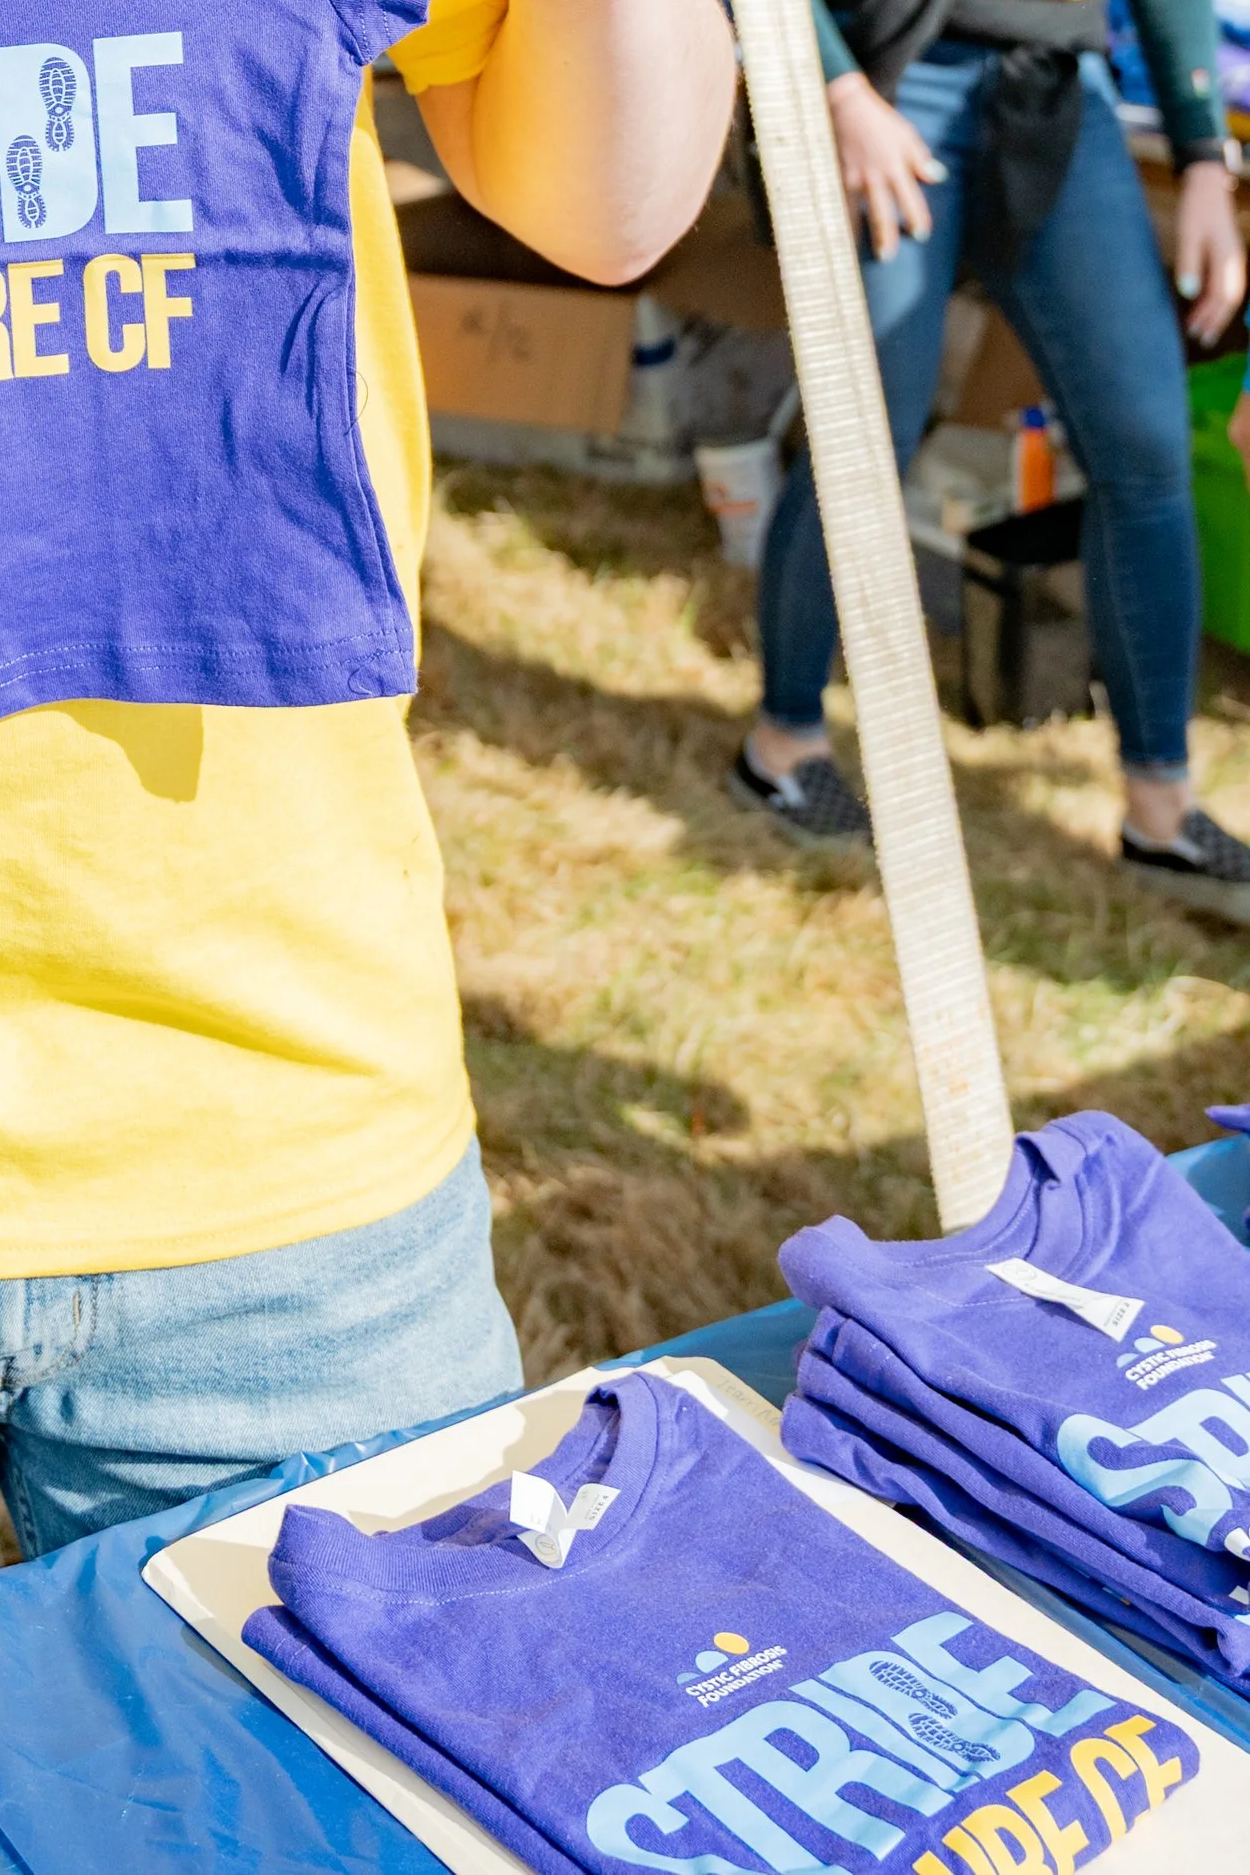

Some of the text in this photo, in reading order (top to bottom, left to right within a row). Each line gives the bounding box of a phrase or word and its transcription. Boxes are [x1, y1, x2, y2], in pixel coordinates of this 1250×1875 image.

[82, 252, 196, 373] CF
[685, 1645, 788, 1697] CYSTIC FIBROSIS
[586, 1610, 1117, 1875] STRIDE
